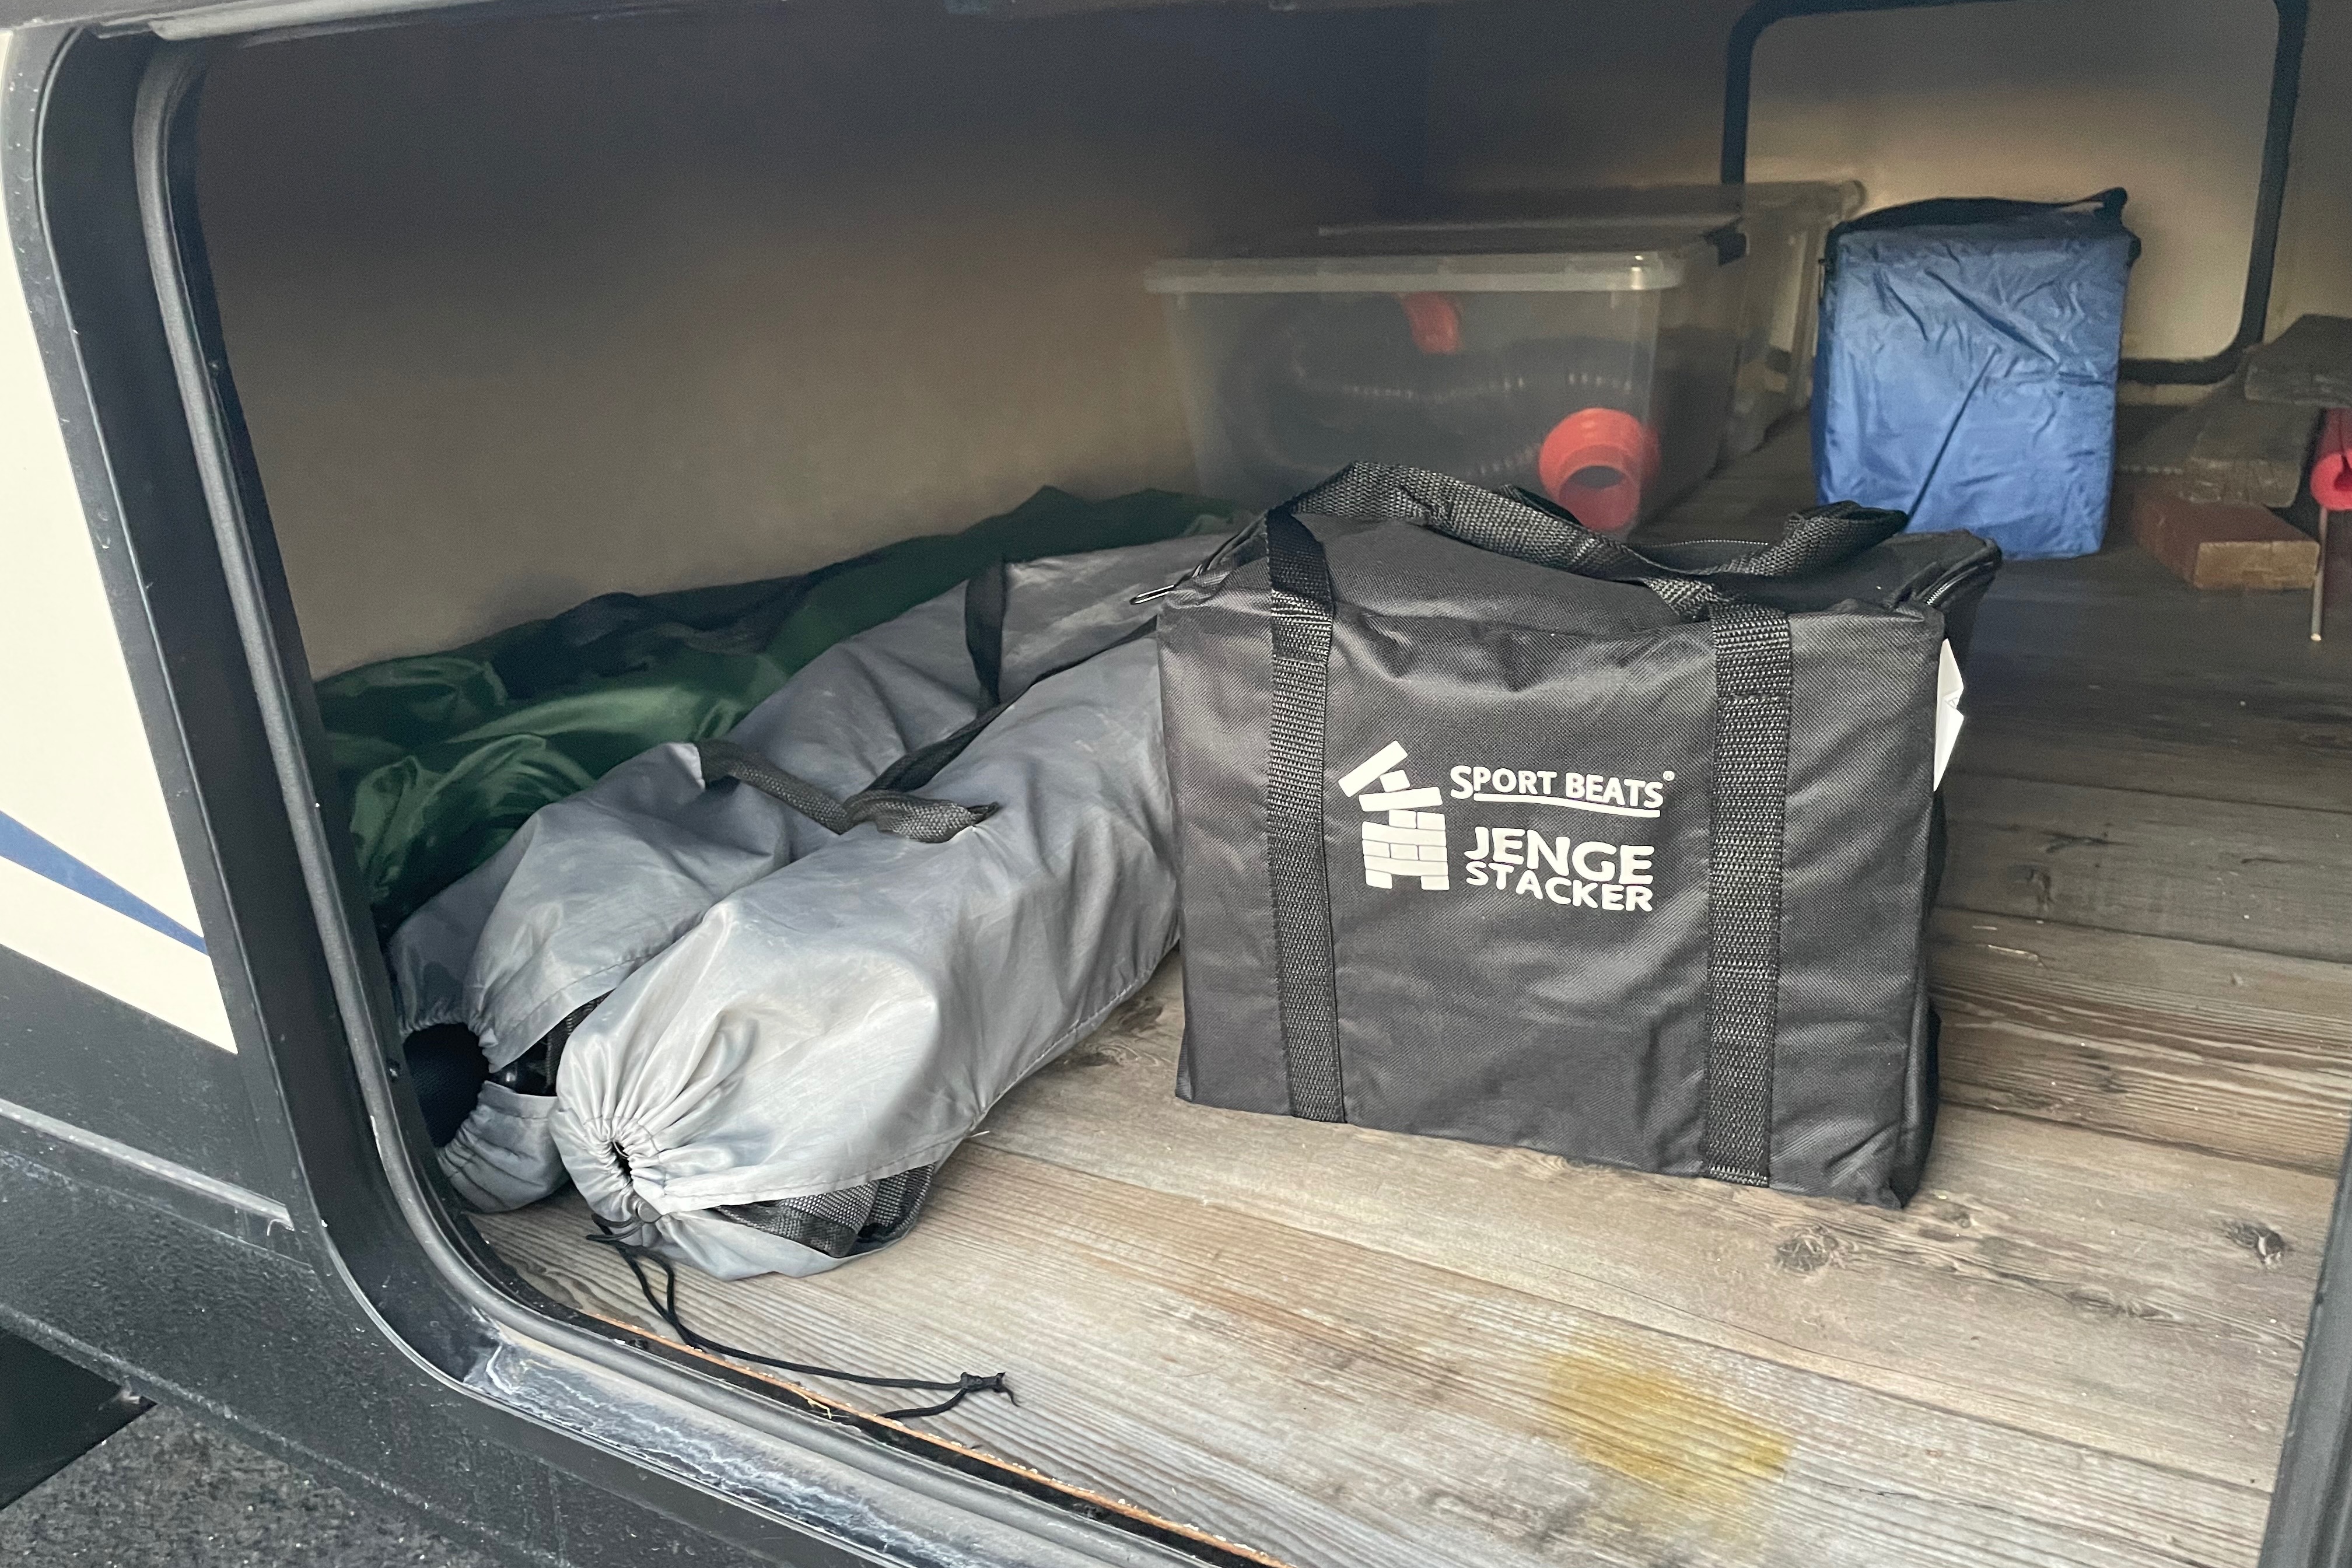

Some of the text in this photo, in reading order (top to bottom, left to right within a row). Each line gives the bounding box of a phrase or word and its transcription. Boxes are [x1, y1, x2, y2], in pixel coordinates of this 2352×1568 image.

[1449, 764, 1558, 800] SPORT
[1463, 825, 1656, 886] JENGE
[1465, 860, 1654, 912] STACKER
